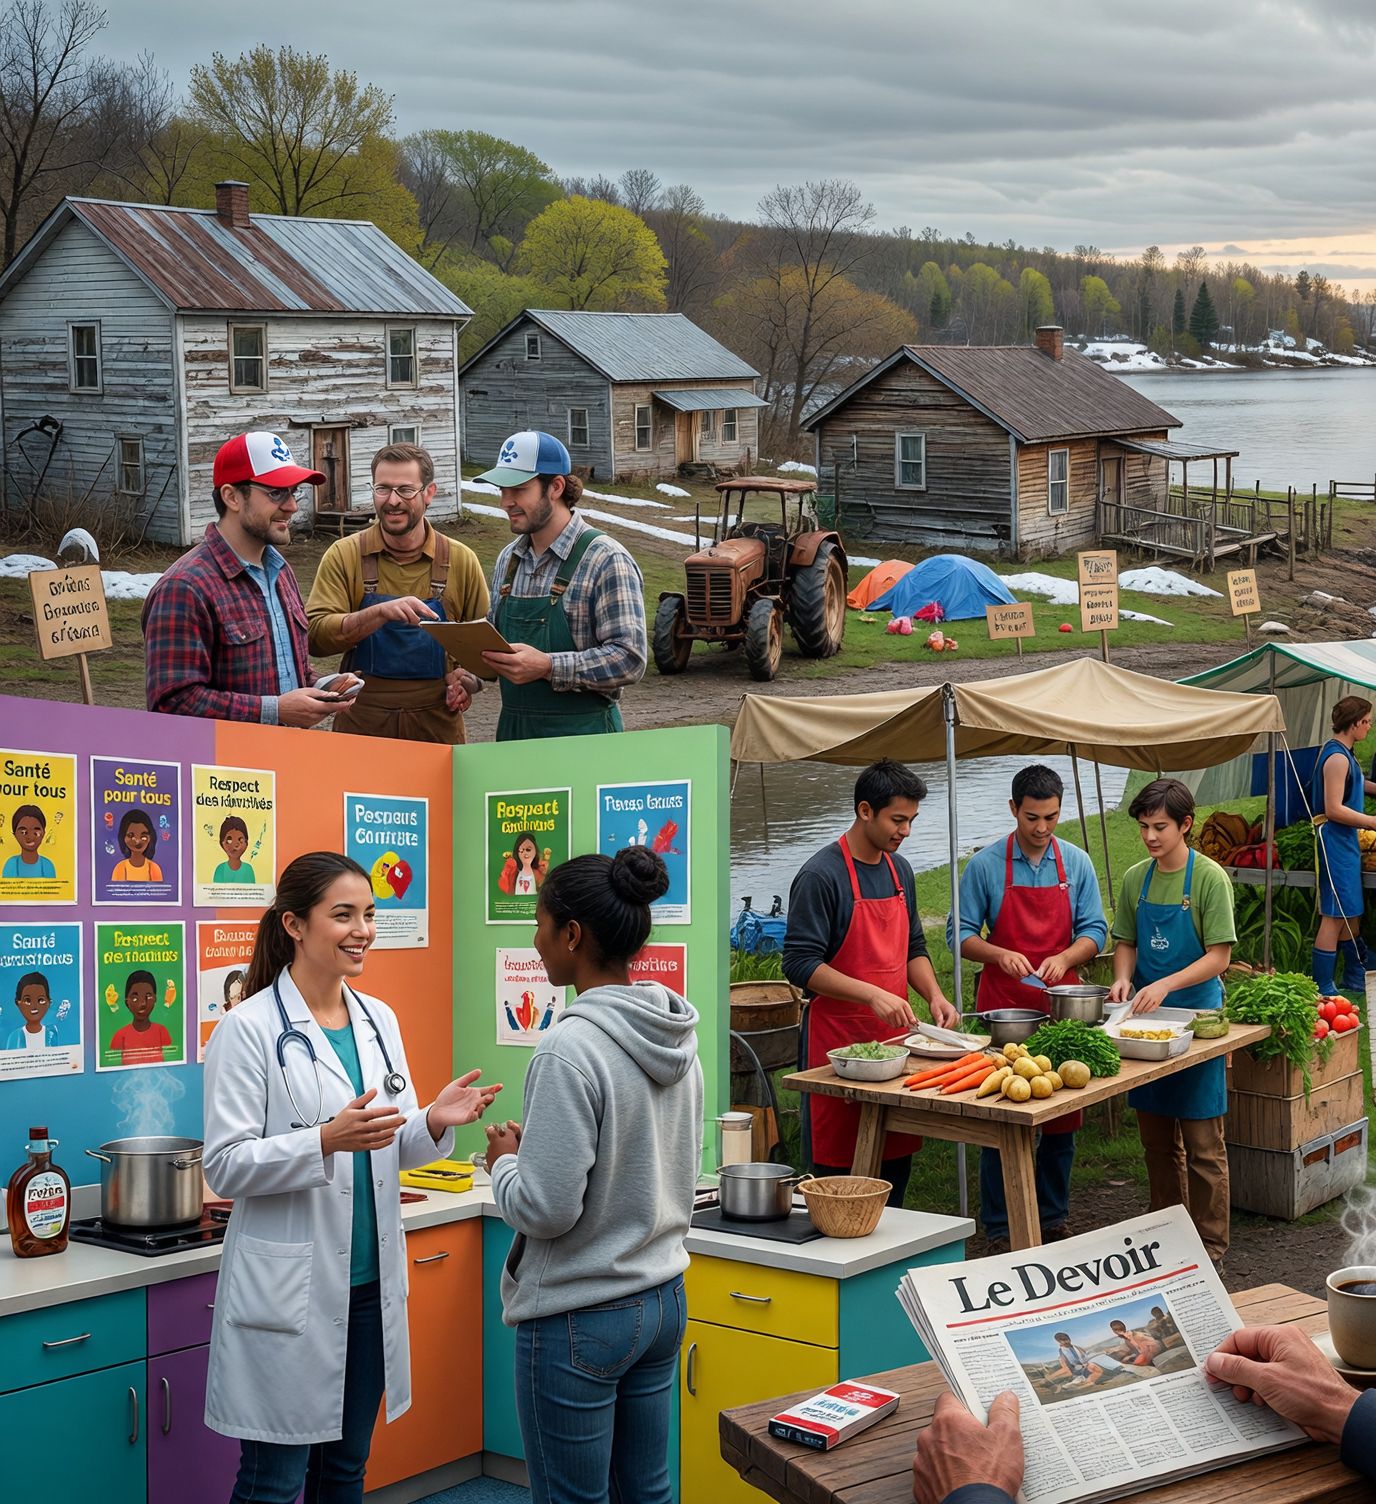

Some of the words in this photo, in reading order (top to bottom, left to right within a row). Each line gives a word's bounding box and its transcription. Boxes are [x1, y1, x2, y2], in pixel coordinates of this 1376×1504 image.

[4, 760, 51, 780] Santé
[114, 767, 158, 788] Santé
[0, 783, 29, 797] our
[33, 780, 67, 799] tous
[103, 789, 138, 804] pour
[140, 789, 172, 806] tous
[948, 1275, 1016, 1314] Le
[1010, 1236, 1163, 1302] Devoir
